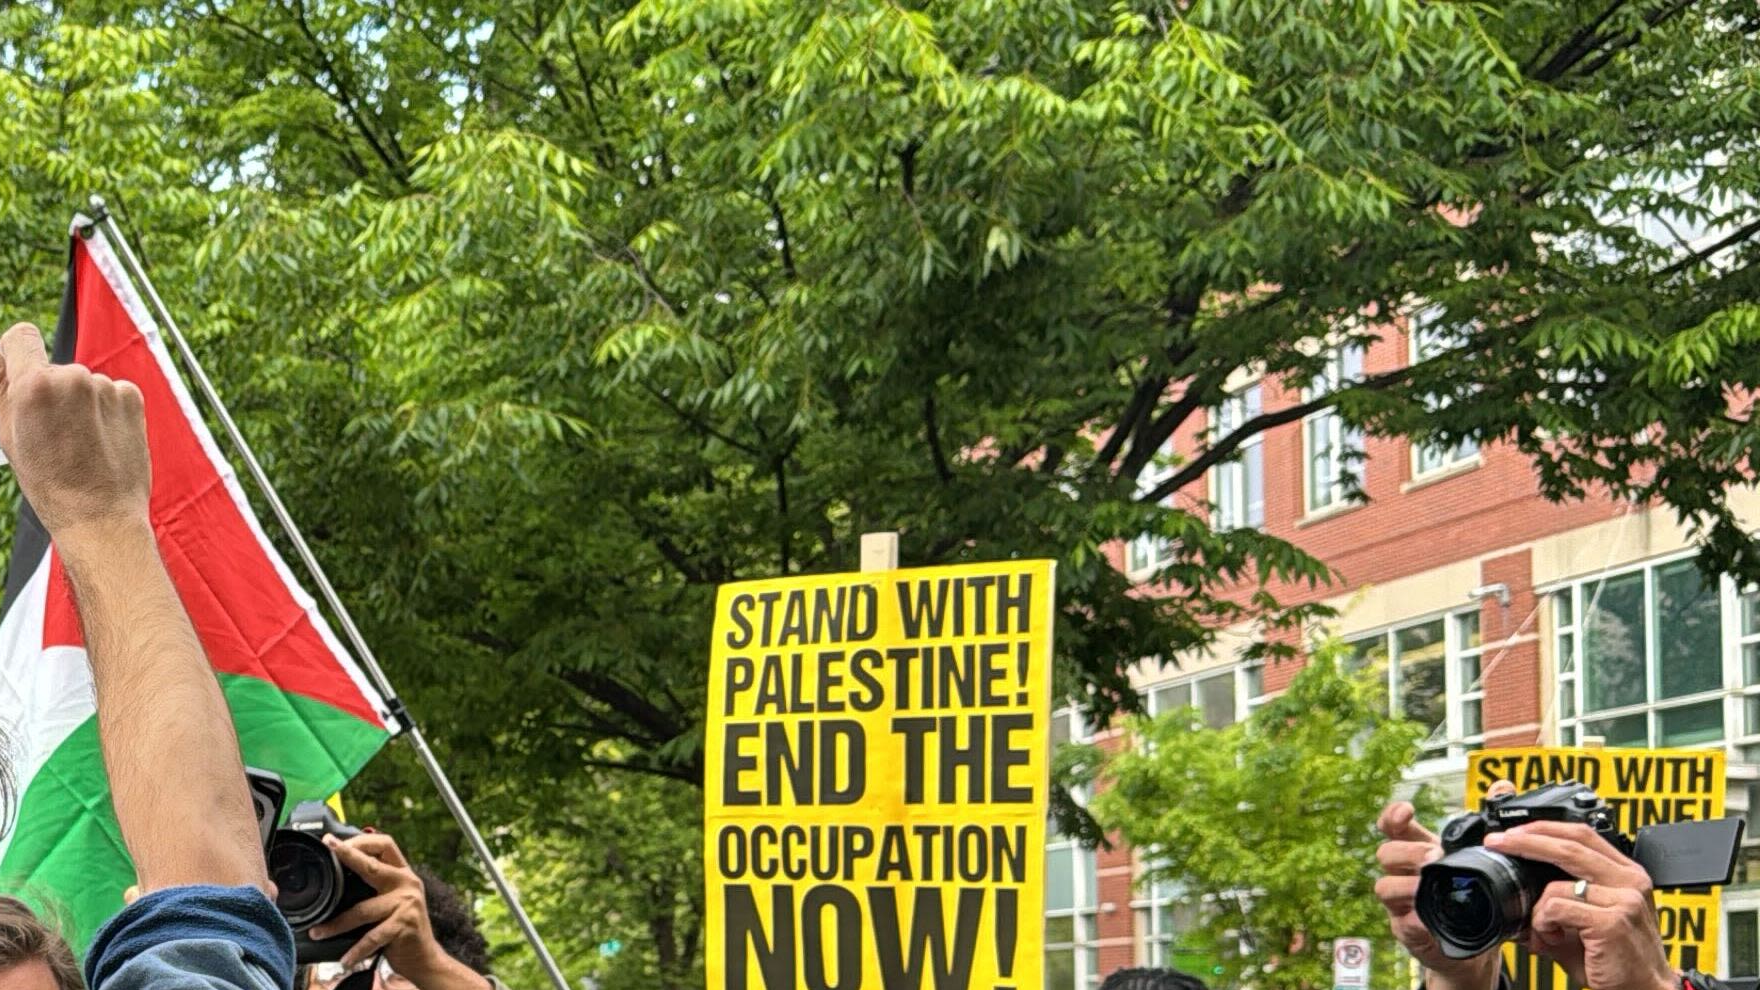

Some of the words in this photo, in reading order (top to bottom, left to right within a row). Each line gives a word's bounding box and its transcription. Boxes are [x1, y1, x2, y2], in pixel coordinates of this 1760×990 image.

[726, 583, 879, 650] STAND
[896, 573, 1032, 639] WITH
[724, 641, 1031, 716] PALESTINE!
[722, 719, 867, 806] END
[891, 713, 1034, 805] THE
[1478, 755, 1601, 791] STAND
[1614, 757, 1713, 793] WITH
[718, 824, 1027, 883] OCCUPATION
